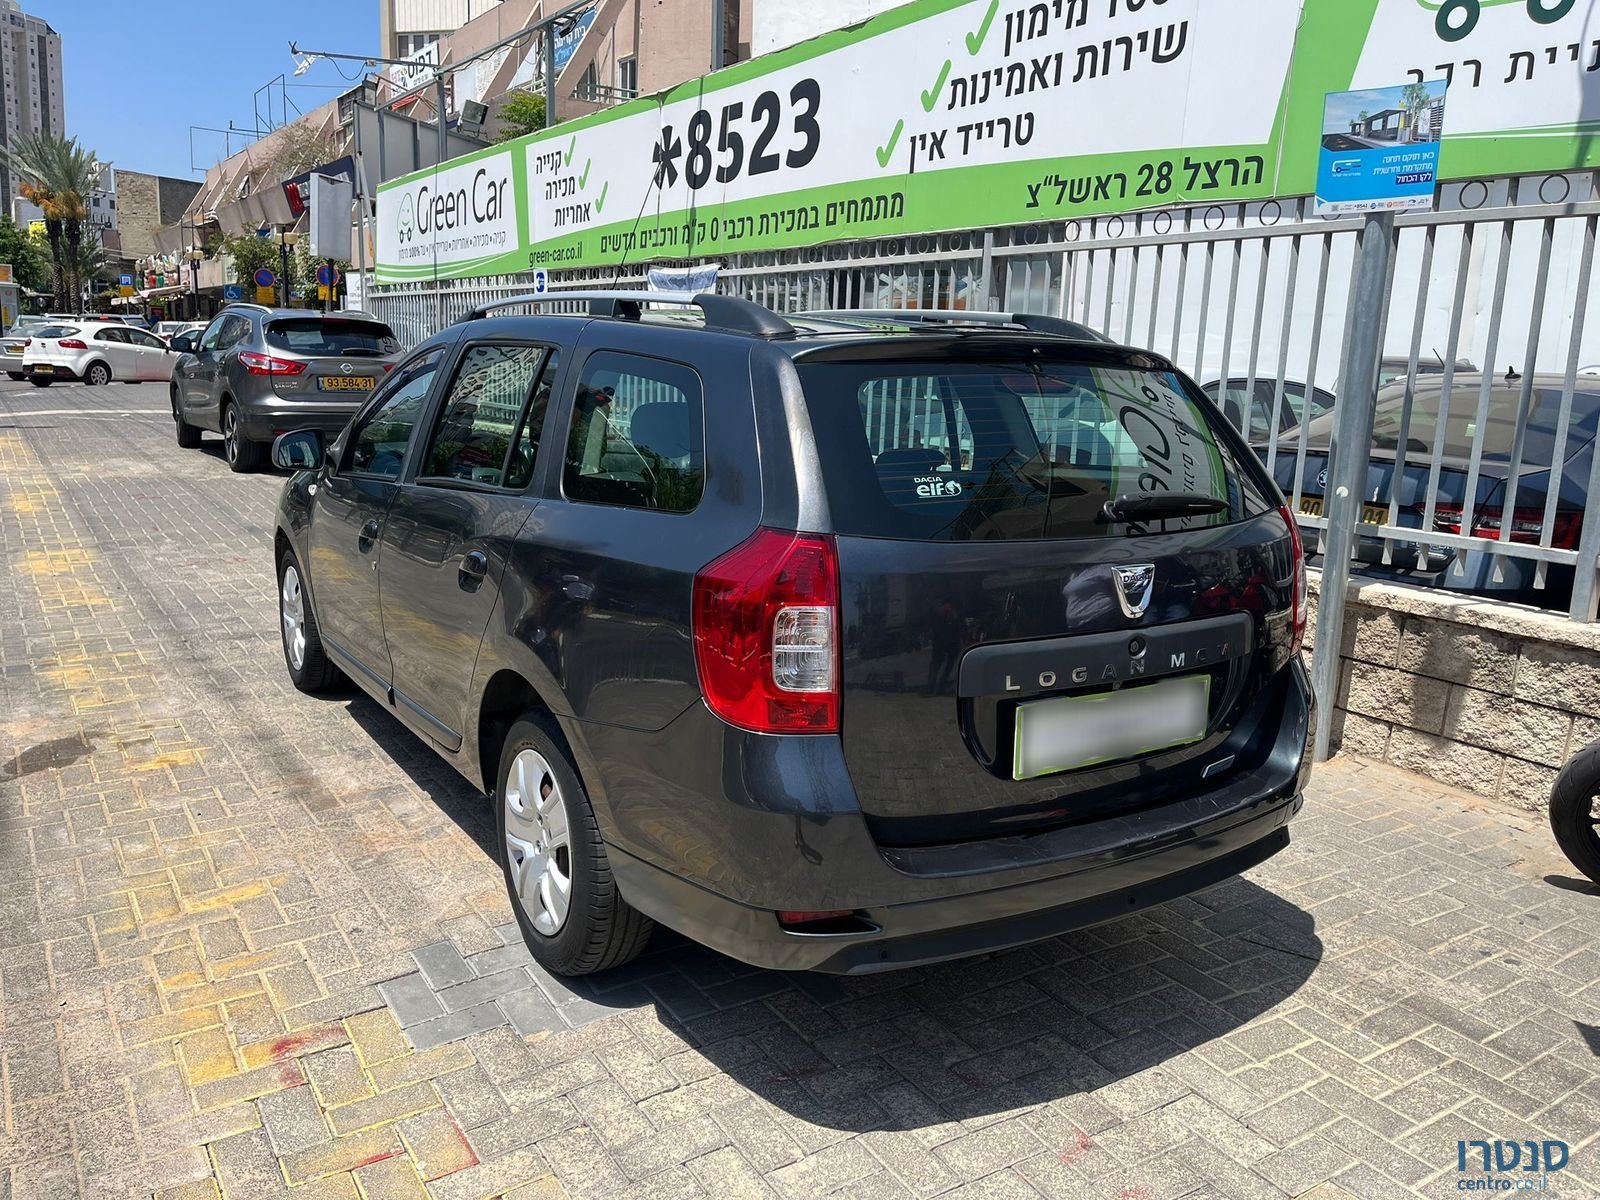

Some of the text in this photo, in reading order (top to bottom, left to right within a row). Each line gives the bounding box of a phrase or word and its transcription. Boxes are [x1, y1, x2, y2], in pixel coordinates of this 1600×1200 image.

[1004, 0, 1089, 57] מימון
[947, 20, 1189, 111] שירות ואמינות
[909, 111, 1035, 174] טרייד אין
[536, 150, 562, 176] קנייה
[1183, 155, 1264, 191] הרצל
[545, 176, 576, 200] מכירה
[1135, 160, 1173, 197] 28
[417, 168, 507, 235] Green Car
[554, 202, 591, 227] אחריות
[825, 192, 905, 227] מתמחים
[710, 217, 719, 242] 0
[723, 216, 754, 240] רכבי
[757, 205, 820, 237] במכירת
[601, 231, 636, 252] חדשים
[640, 228, 678, 249] ורכבים
[529, 241, 583, 268] green-car.co.il
[914, 476, 943, 484] DACIA
[916, 483, 944, 496] elf
[1005, 658, 1145, 691] LOGAN
